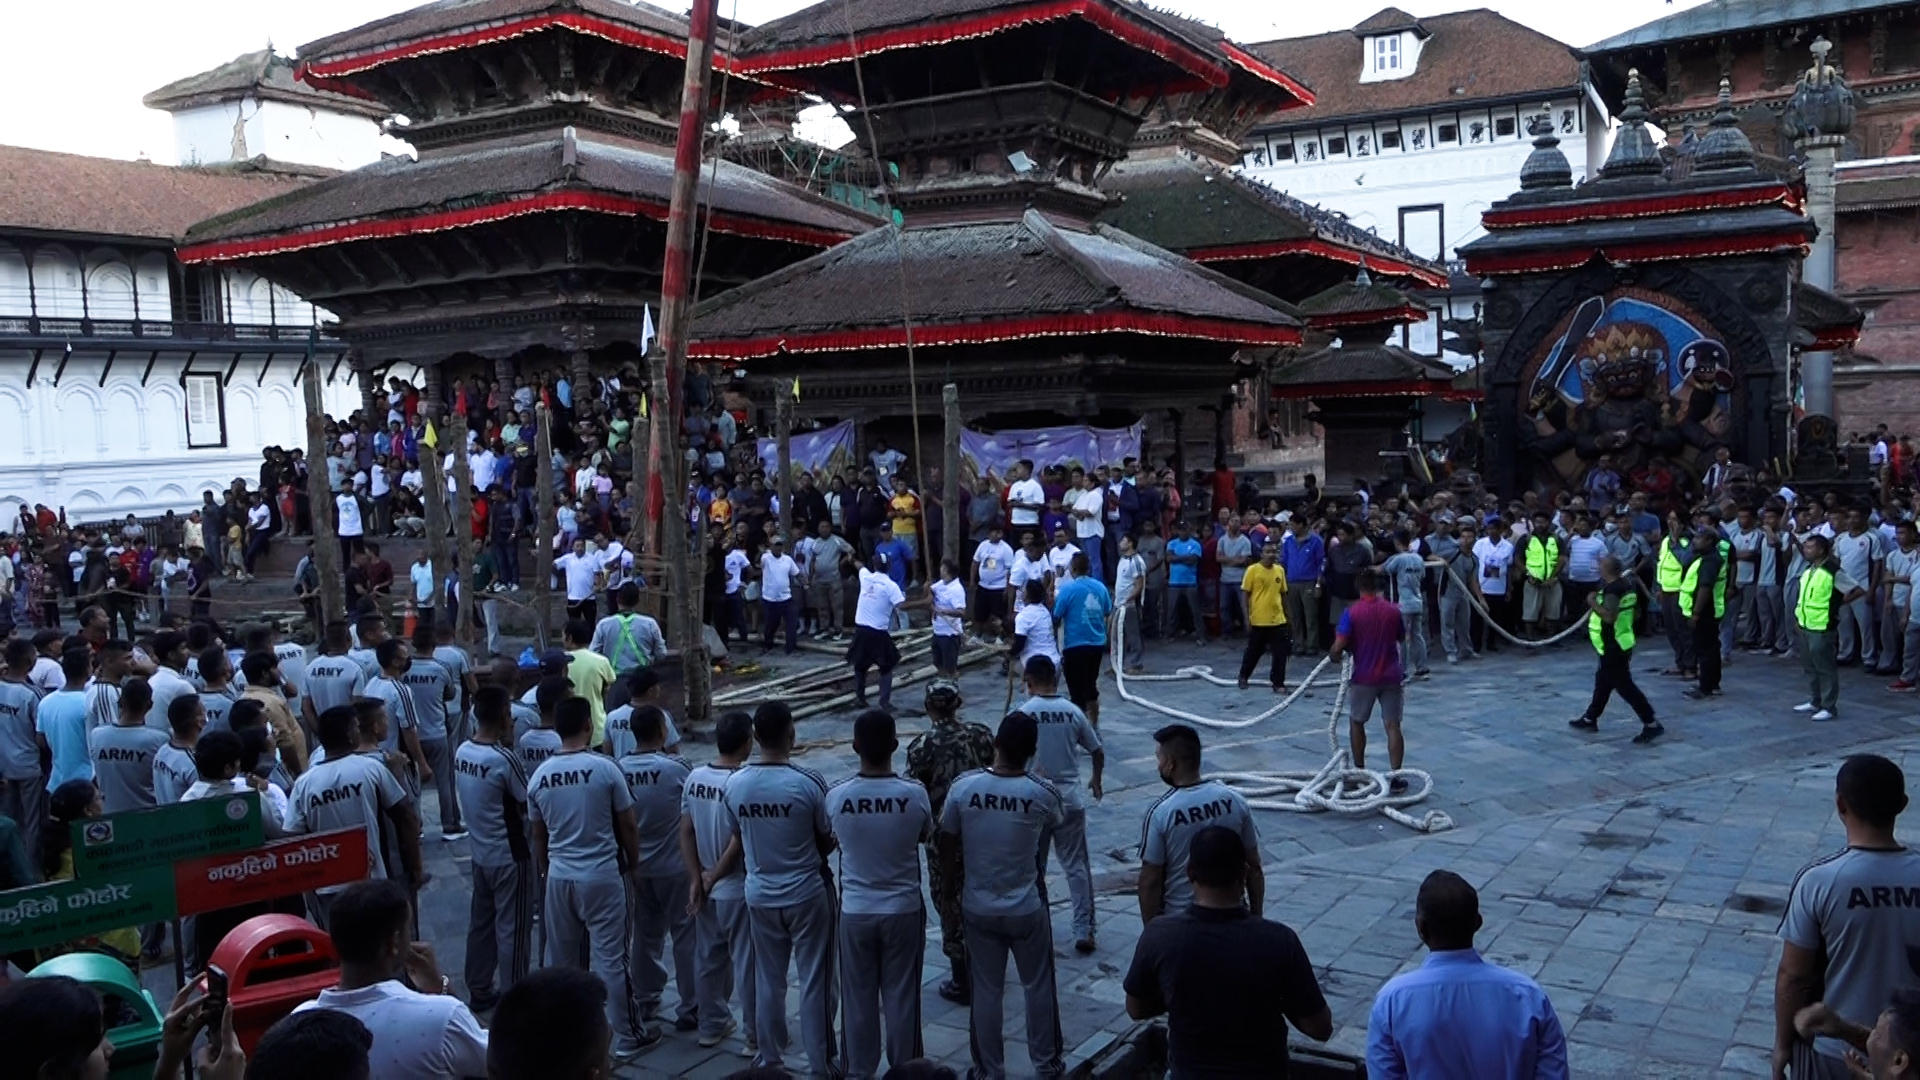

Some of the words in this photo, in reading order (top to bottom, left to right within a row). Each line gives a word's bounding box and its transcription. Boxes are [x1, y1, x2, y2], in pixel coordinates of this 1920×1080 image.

[311, 667, 343, 678] ARMY
[402, 675, 437, 684] ARMY
[611, 719, 628, 730] AR
[1030, 711, 1074, 723] ARMY
[98, 748, 146, 762] ARMY
[538, 769, 593, 790] ARMY
[625, 770, 661, 787] RMY
[310, 782, 363, 808] ARMY
[688, 783, 724, 803] ARMY
[738, 803, 793, 818] ARMY
[840, 798, 909, 814] ARMY
[968, 793, 1033, 814] ARMY
[1174, 799, 1231, 826] ARMY
[283, 843, 340, 867] फोहोर
[67, 883, 134, 909] फोहोर
[1847, 886, 1920, 909] ARM
